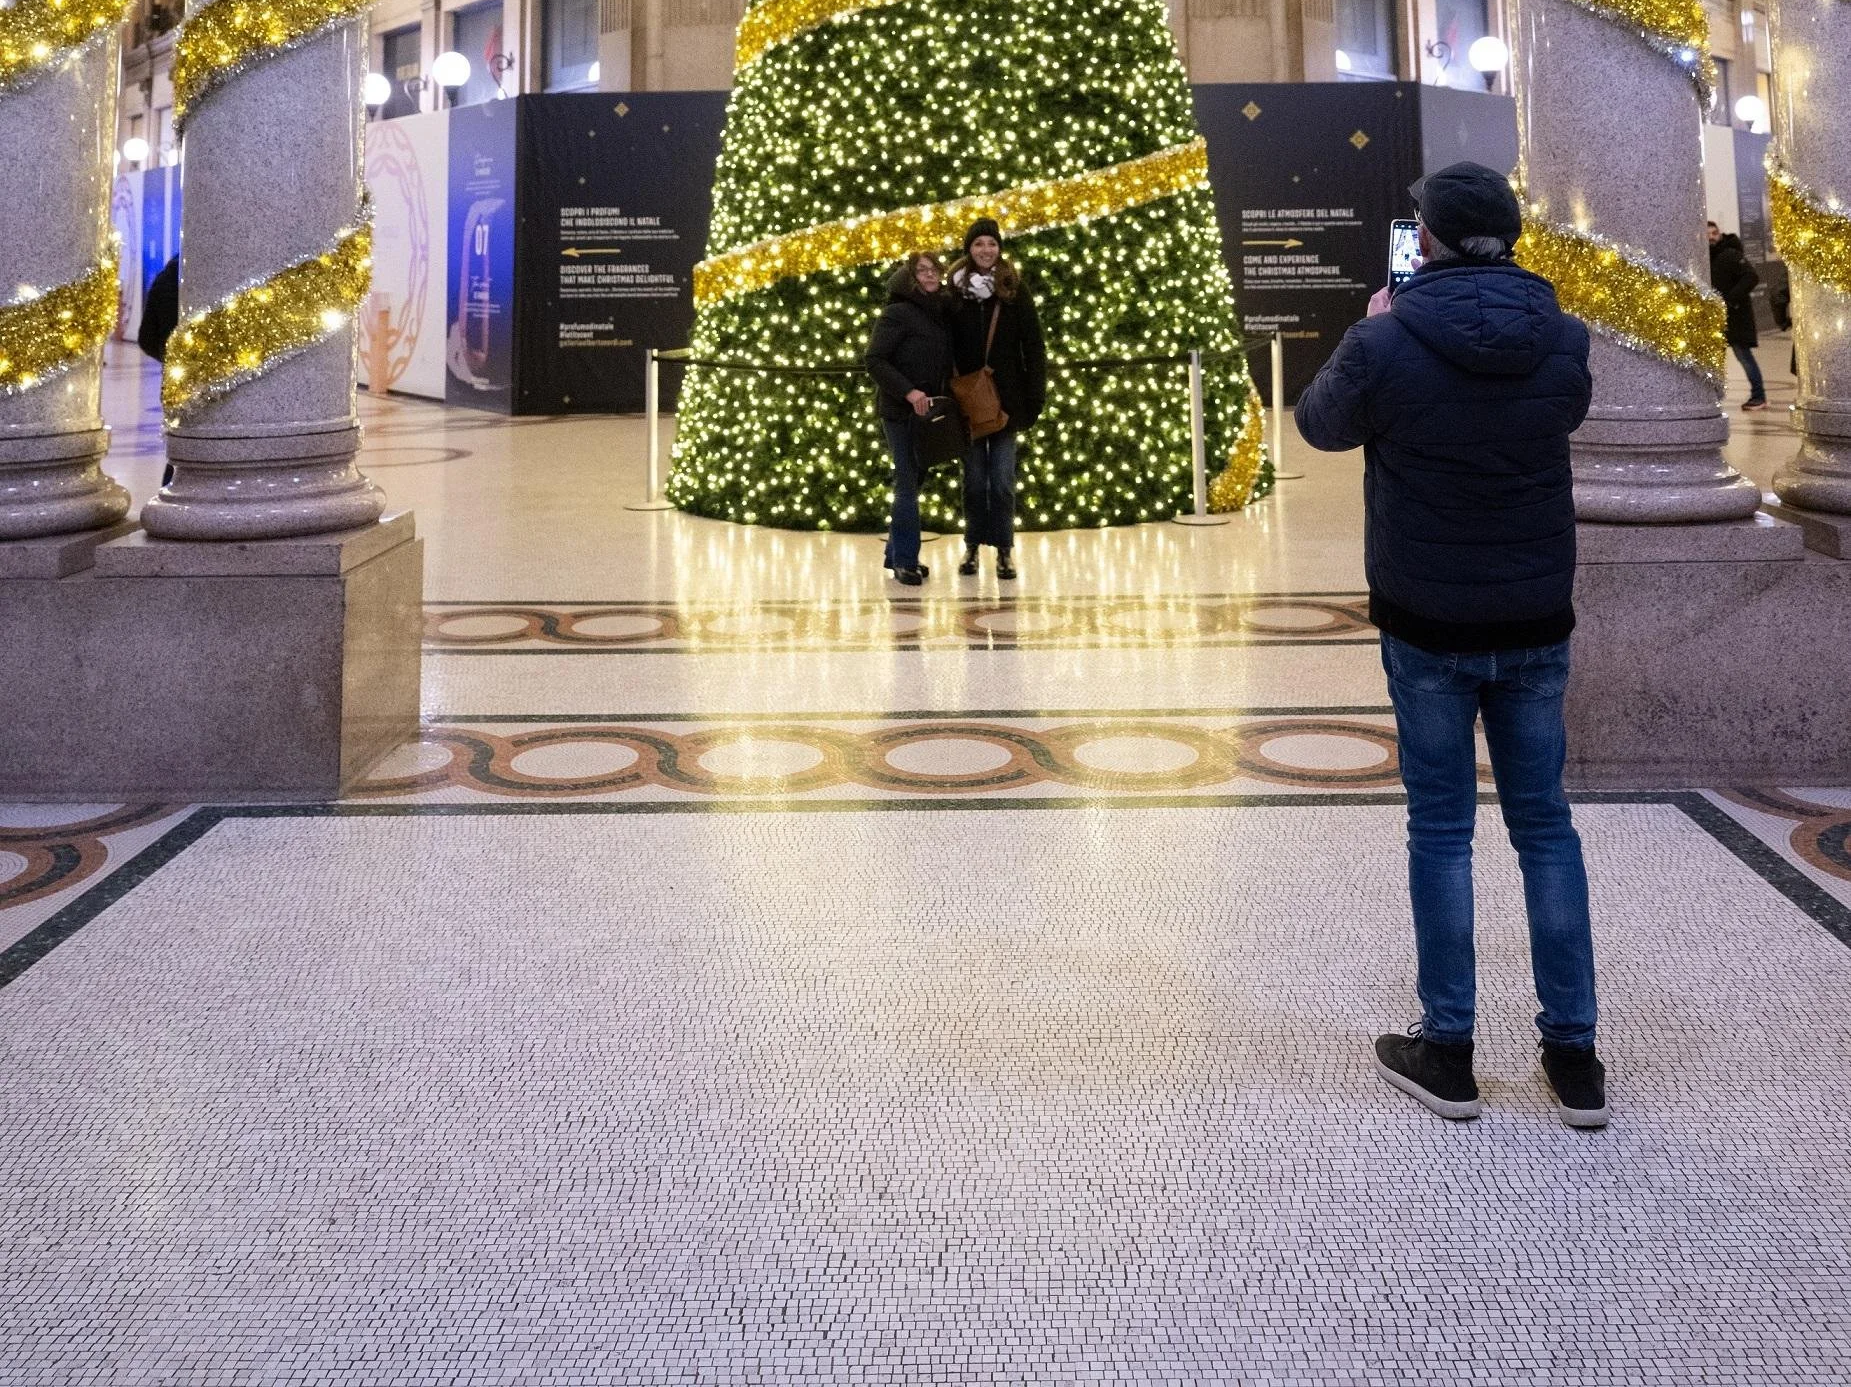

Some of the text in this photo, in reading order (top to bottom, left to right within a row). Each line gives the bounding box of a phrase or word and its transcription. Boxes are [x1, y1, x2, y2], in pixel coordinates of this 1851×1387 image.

[1242, 208, 1354, 219] SCOPRI LE ATMOSFERE DEL NATALE
[560, 217, 574, 227] CHE
[629, 217, 636, 226] IL
[637, 216, 660, 226] NATALE
[1243, 254, 1320, 265] COME AND EXPERIENCE
[560, 264, 650, 274] DISCOVER THE FRAGRANCES
[1244, 266, 1340, 277] THE CHRISTMAS ATMOSPHERE
[560, 274, 674, 284] THAT MAKE CHRISTMAS DELIGHTFUL
